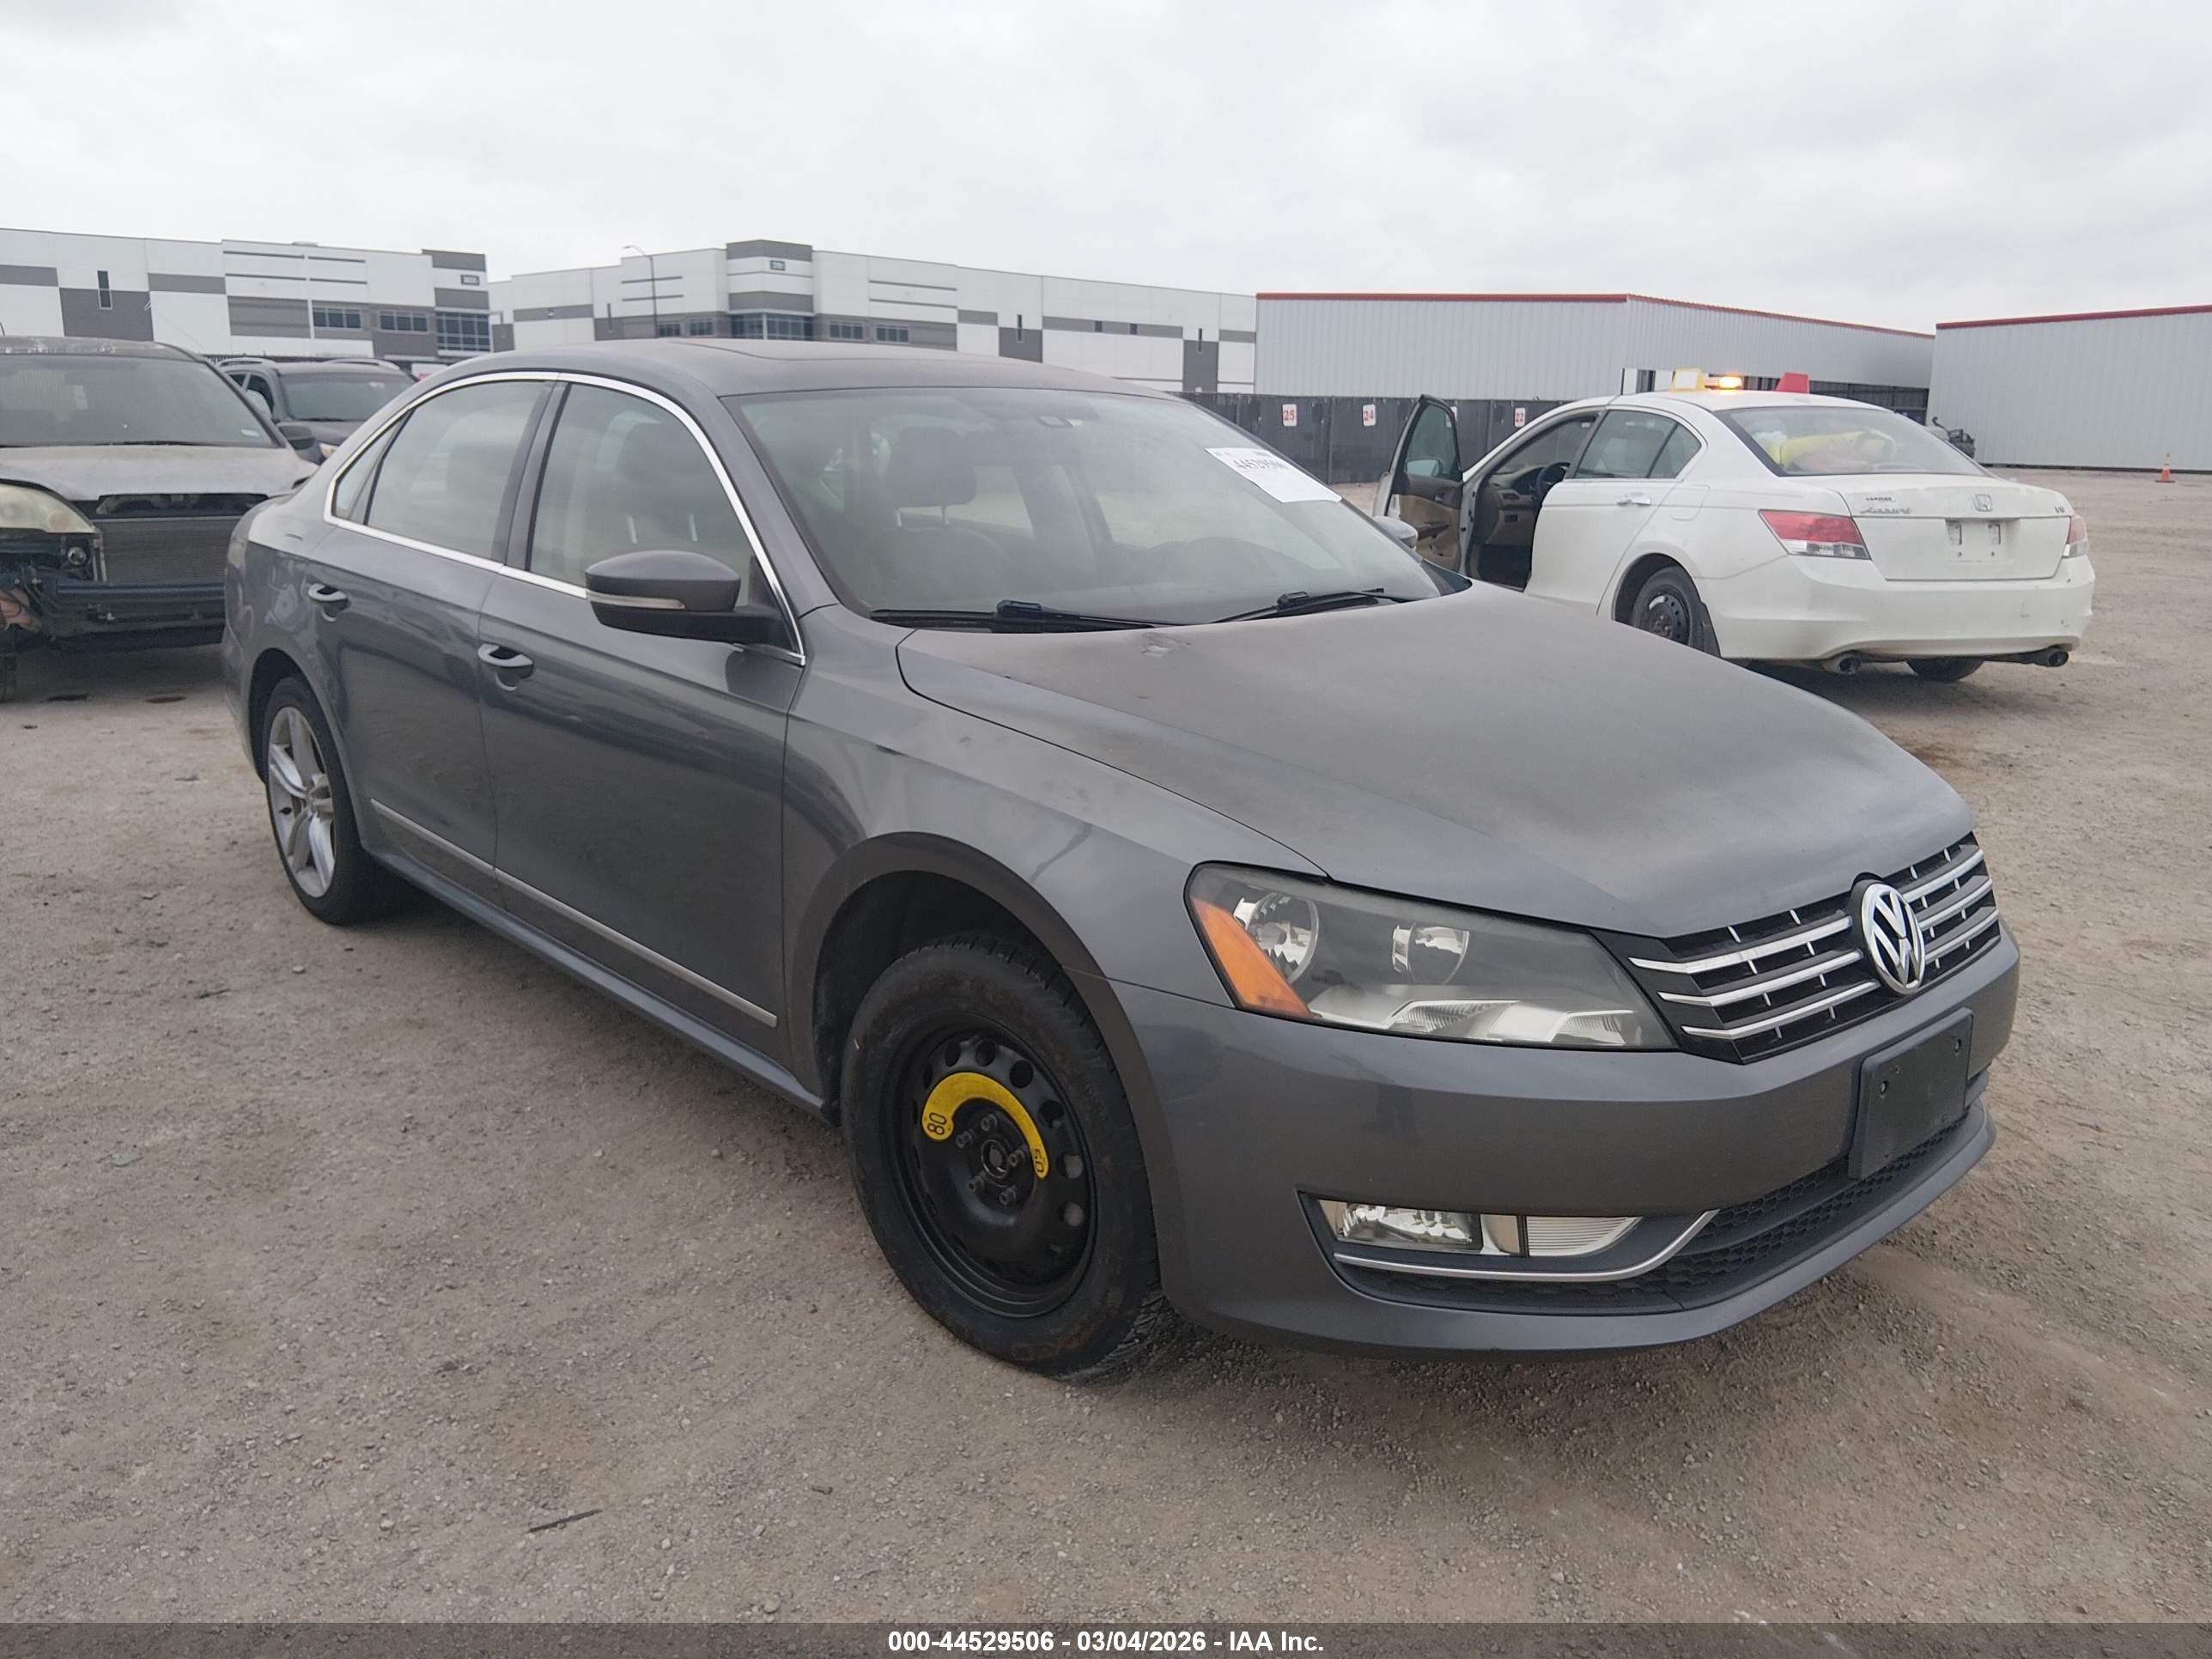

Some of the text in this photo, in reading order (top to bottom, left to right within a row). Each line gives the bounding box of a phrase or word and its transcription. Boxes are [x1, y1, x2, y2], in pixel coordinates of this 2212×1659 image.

[1284, 410, 1295, 421] 25
[1364, 410, 1374, 421] 24
[927, 1112, 947, 1135] 80
